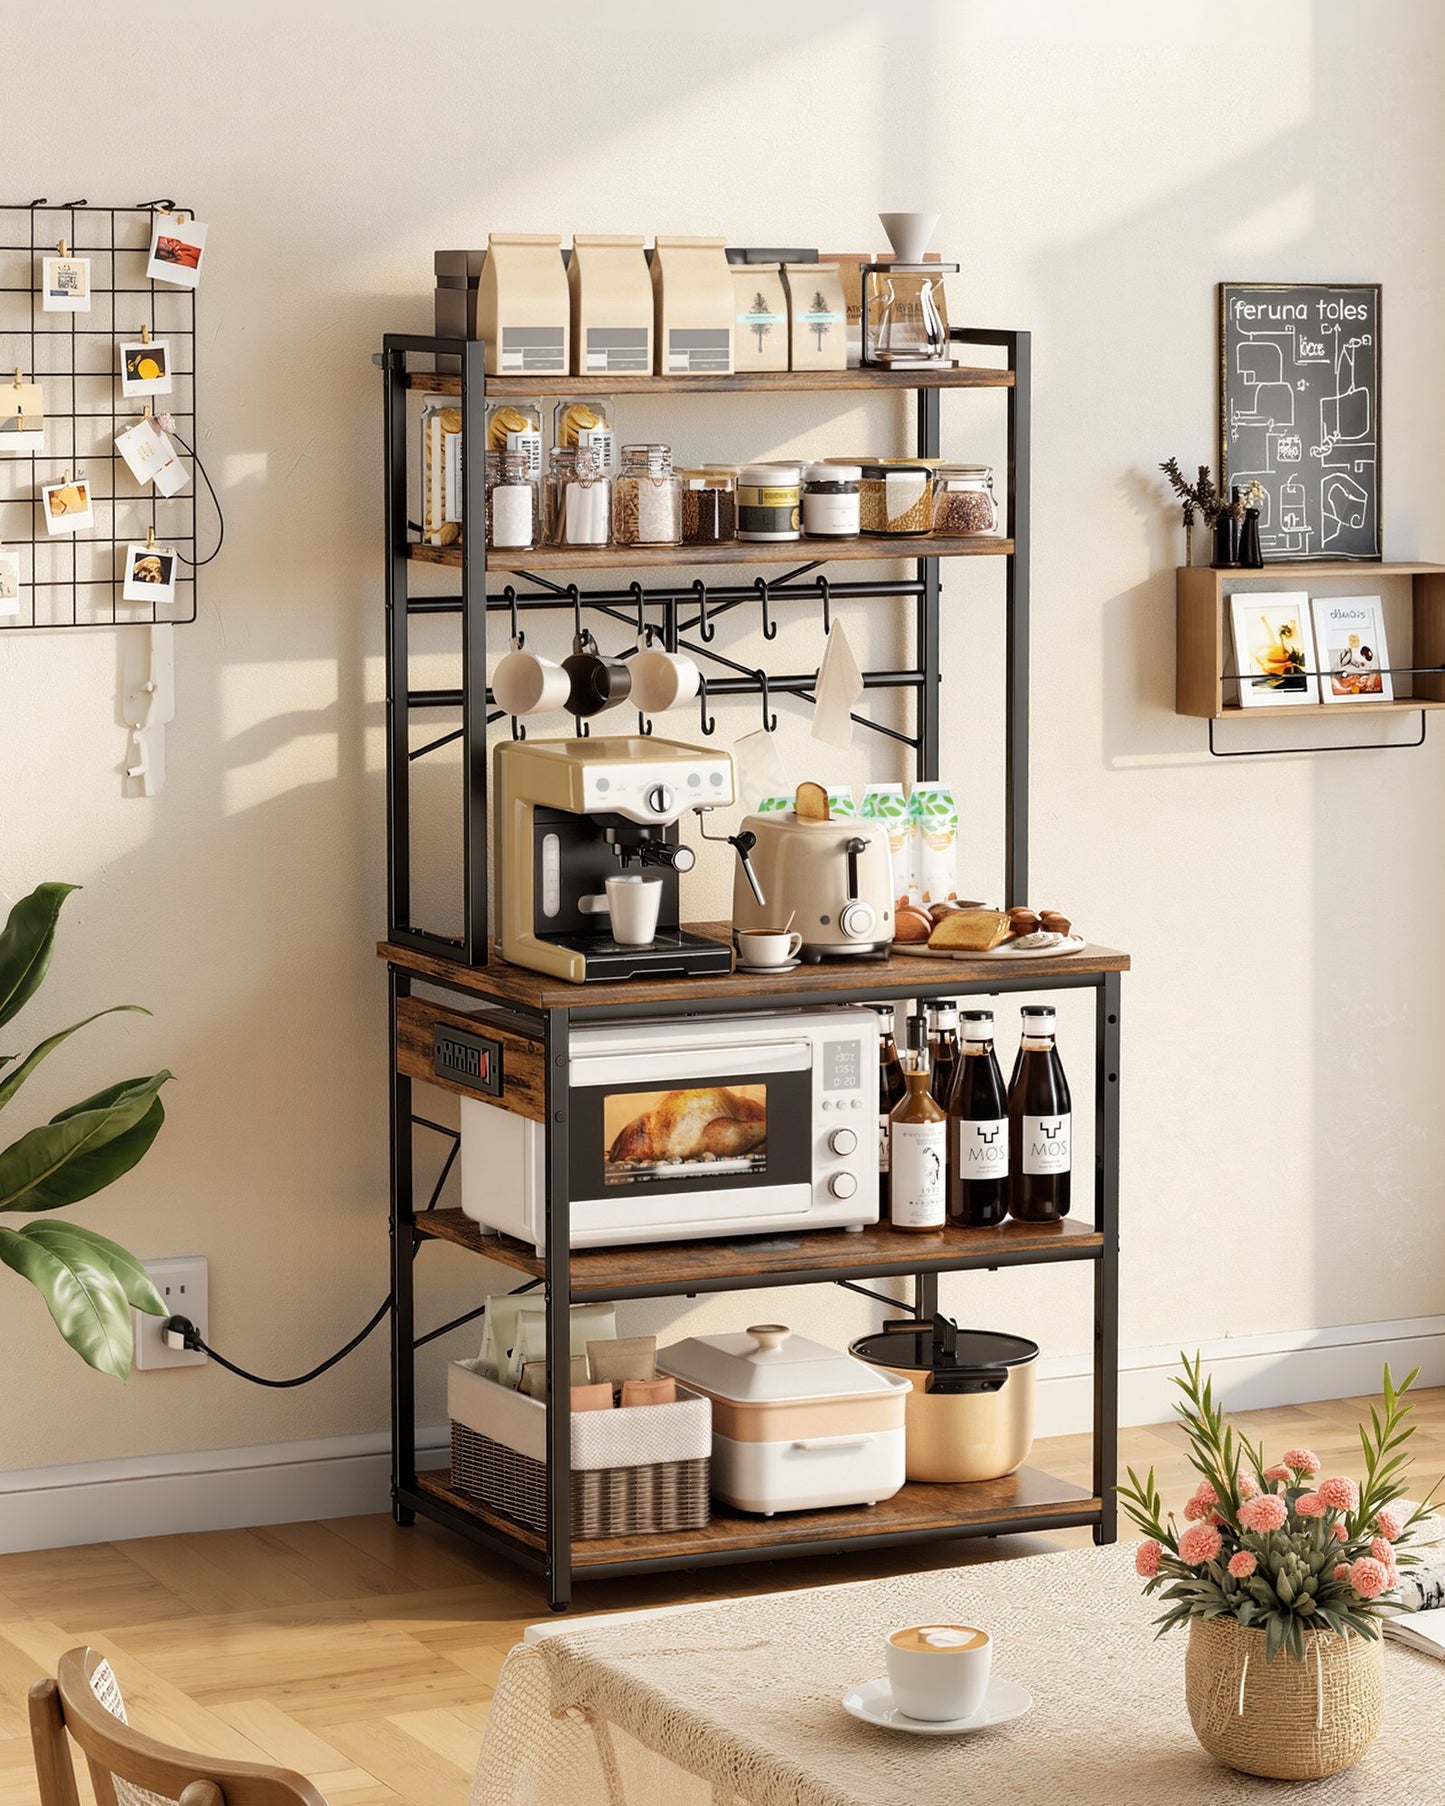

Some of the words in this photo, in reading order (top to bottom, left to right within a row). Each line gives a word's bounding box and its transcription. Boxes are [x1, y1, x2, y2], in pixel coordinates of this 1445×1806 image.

[1315, 298, 1368, 320] toles
[532, 440, 540, 470] SMOKED
[603, 437, 611, 467] SMOKED
